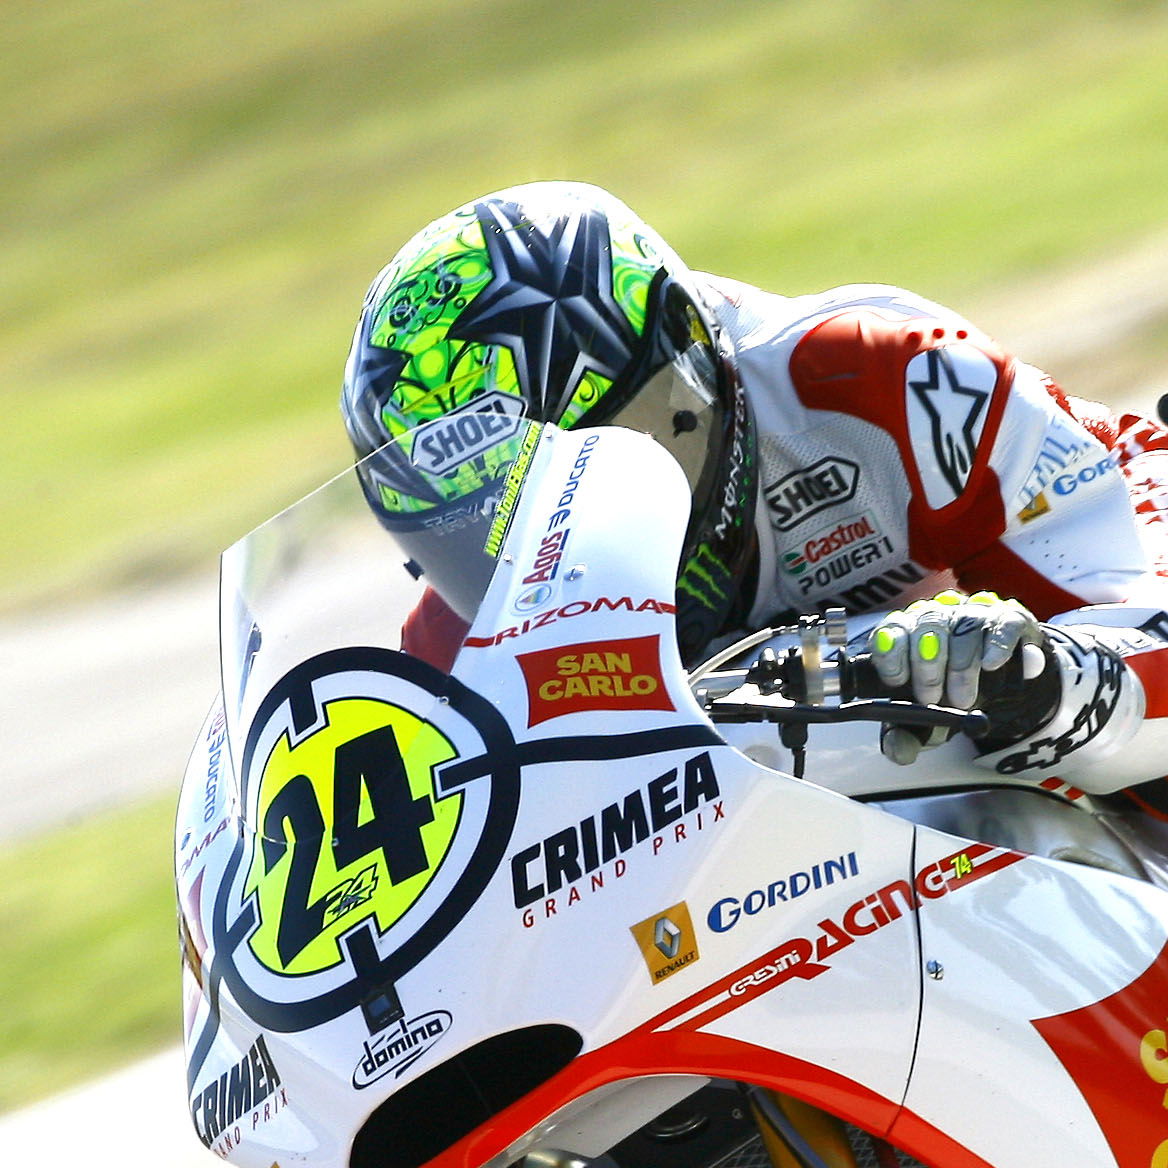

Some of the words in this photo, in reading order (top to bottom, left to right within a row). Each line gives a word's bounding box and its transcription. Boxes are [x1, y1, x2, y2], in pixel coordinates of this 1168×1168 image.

[419, 400, 513, 468] SHOEI
[767, 464, 850, 525] SHOEI
[522, 530, 566, 585] Agos
[803, 515, 877, 565] Castrol
[494, 597, 663, 646] RIZOMA
[538, 674, 659, 702] CARLO
[556, 651, 633, 676] SAN
[263, 724, 436, 970] 24
[507, 752, 721, 910] CRIMEA
[522, 862, 627, 929] GRAND
[652, 801, 726, 855] PRIX
[706, 851, 859, 933] GORDINI
[949, 853, 975, 880] 74
[653, 951, 698, 981] RENAULT
[361, 1018, 444, 1078] domino
[252, 1087, 290, 1132] PRIX
